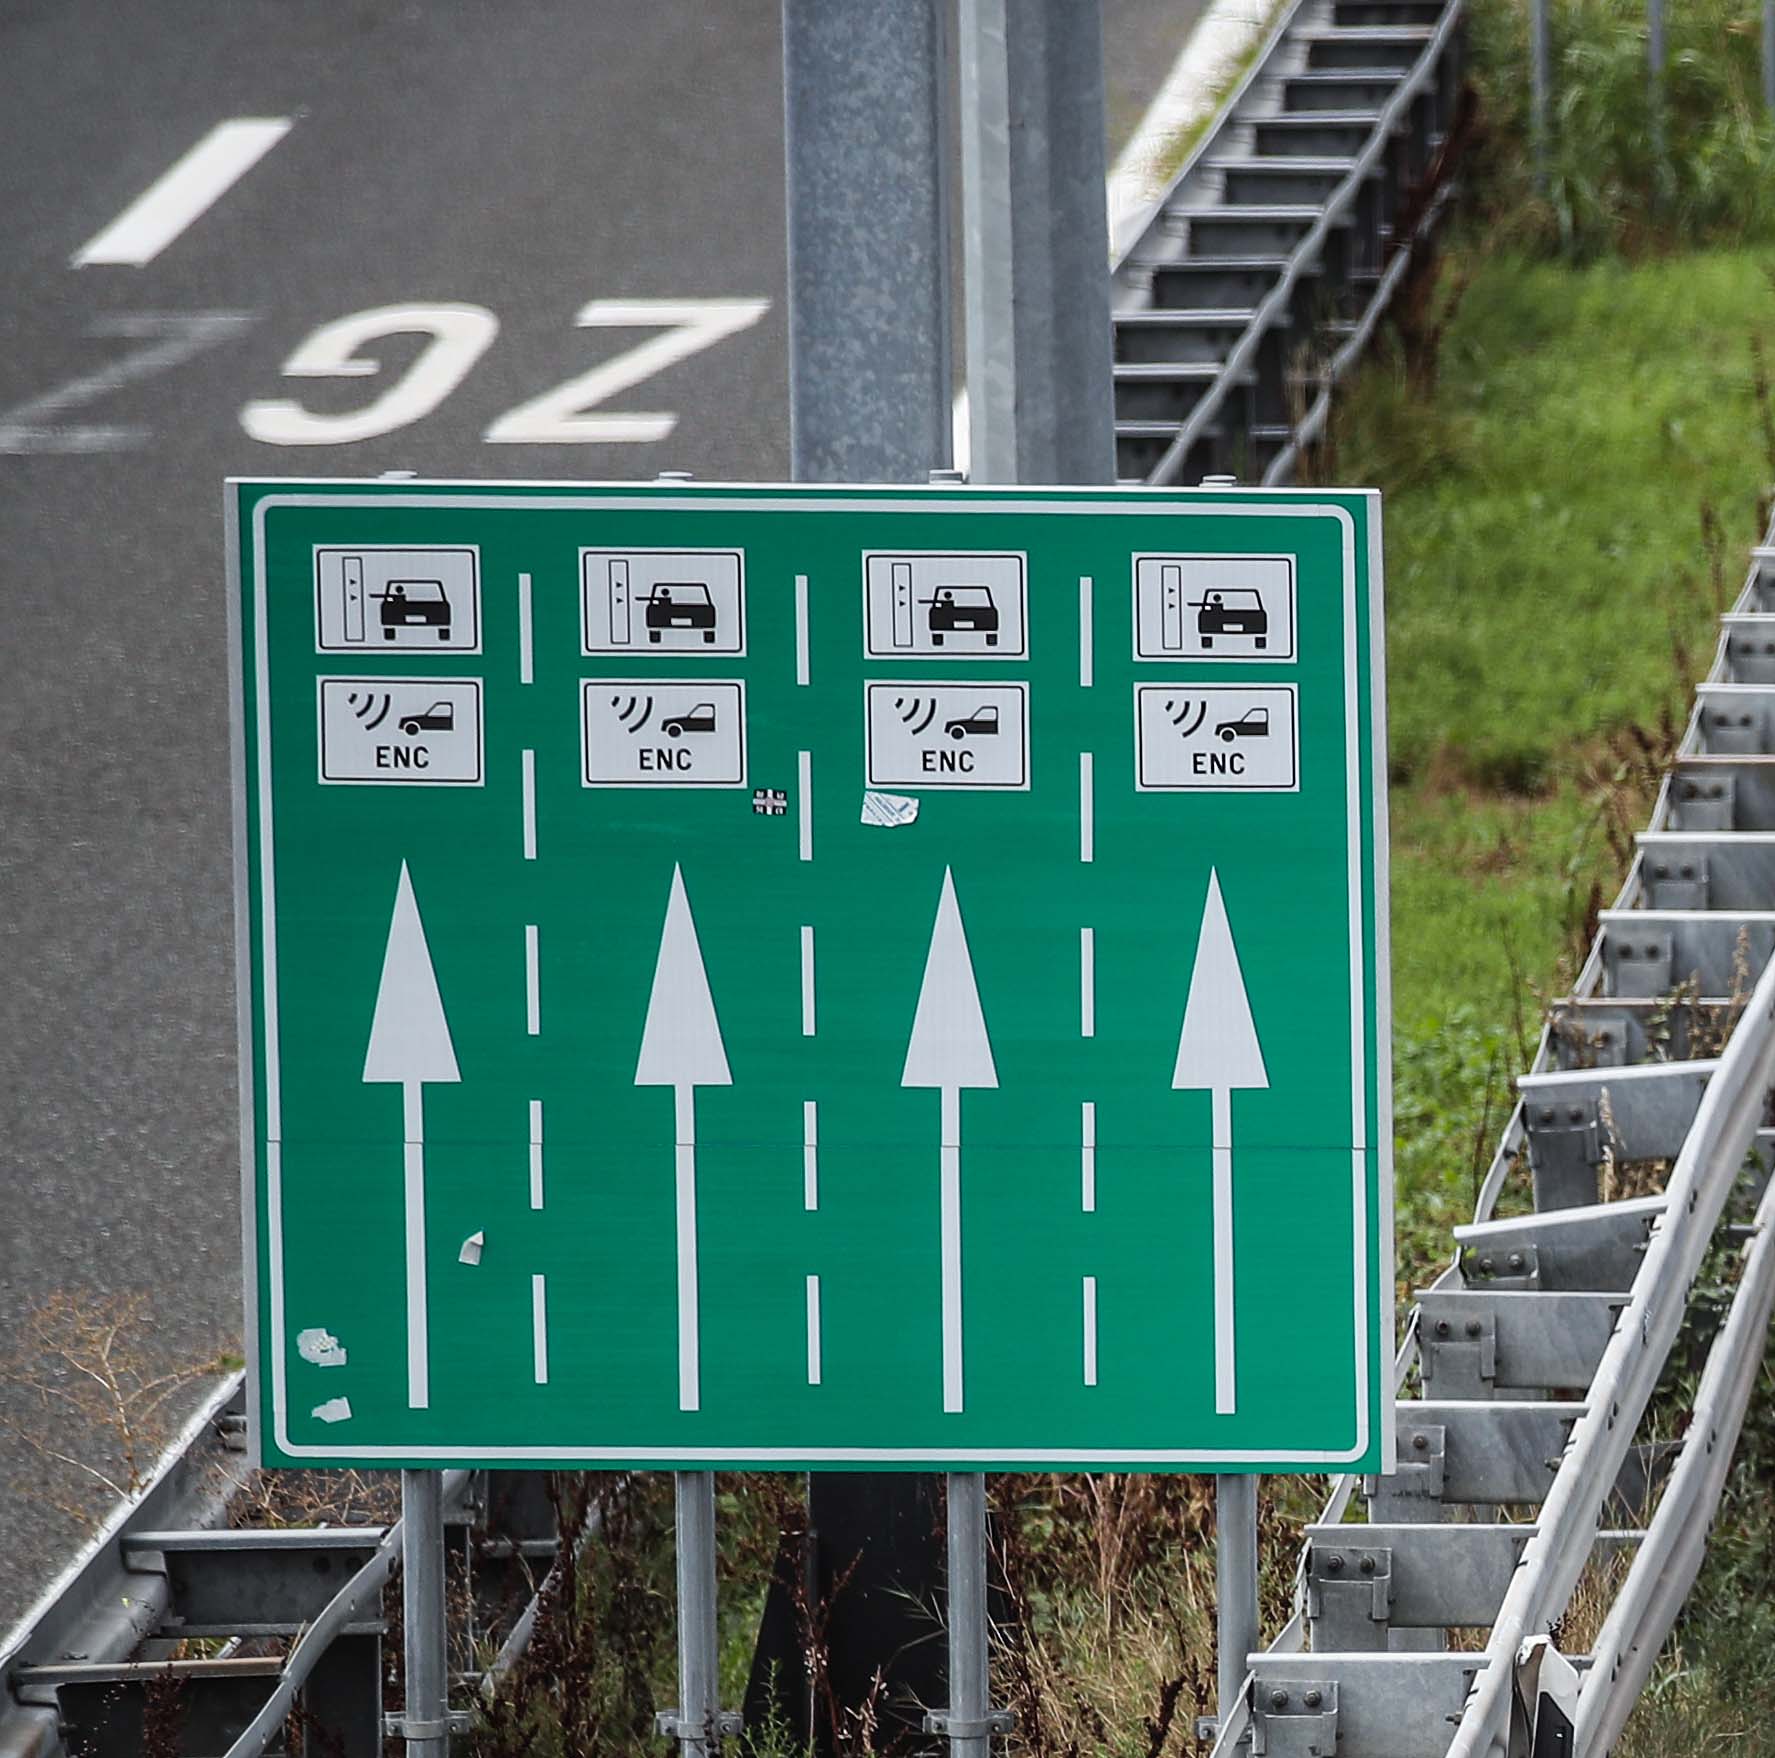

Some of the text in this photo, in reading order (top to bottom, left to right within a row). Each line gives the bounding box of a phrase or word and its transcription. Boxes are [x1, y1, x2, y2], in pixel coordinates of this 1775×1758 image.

[375, 745, 430, 770] ENC
[638, 747, 693, 772] ENC
[920, 749, 975, 773] ENC
[1192, 752, 1246, 776] ENC
